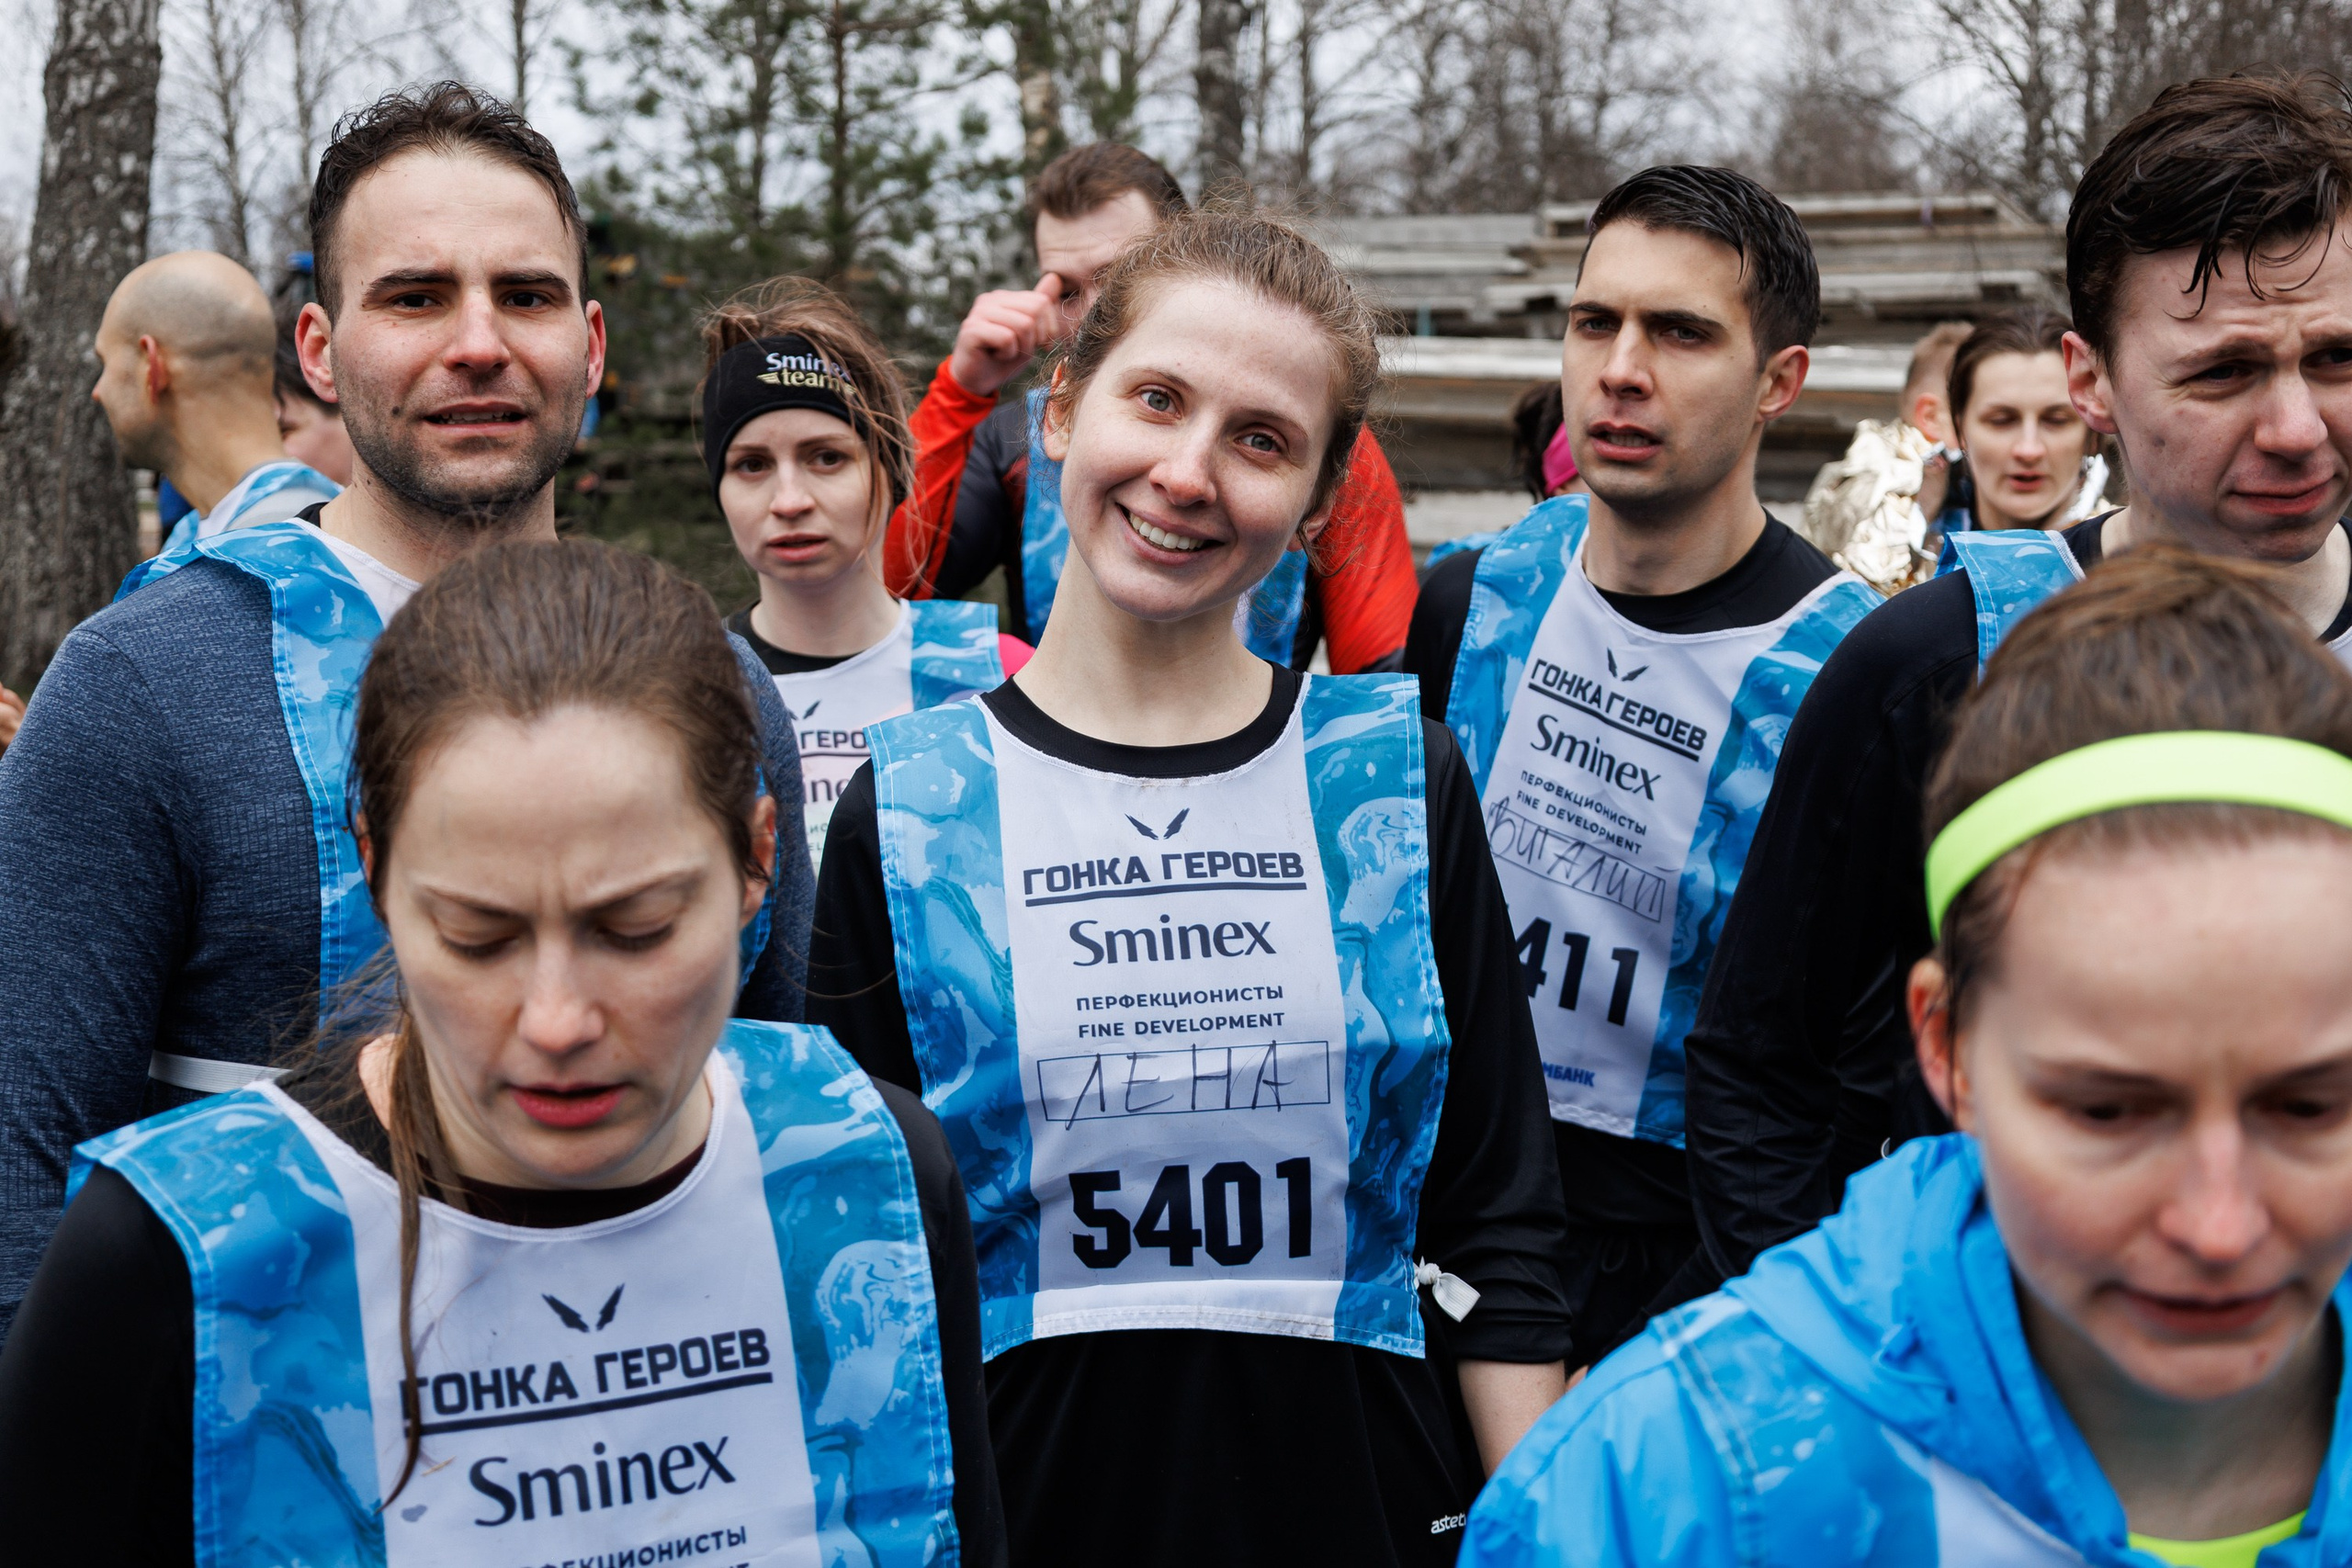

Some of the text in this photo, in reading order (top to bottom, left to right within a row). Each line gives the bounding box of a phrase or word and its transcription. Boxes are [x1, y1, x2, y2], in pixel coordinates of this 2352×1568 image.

[781, 368, 841, 391] team
[1530, 659, 1708, 752] ГОНКА ГЕРОЕВ
[800, 729, 866, 750] ГЕРО
[1529, 713, 1661, 801] Sminex
[1517, 790, 1643, 855] FINE DEVELOPMENT
[1521, 770, 1647, 837] ПЕРФЕКЦИОНИСТЫ
[1023, 851, 1305, 896] ГОНКА ГЕРОЕВ
[1069, 914, 1277, 966] Sminex
[1512, 915, 1640, 1027] 411
[1076, 985, 1284, 1010] ПЕРФЕКЦИОНИСТЫ
[1078, 1012, 1285, 1039] FINE DEVELOPMENT
[1066, 1040, 1295, 1131] ЛЕНА
[1543, 1061, 1596, 1088] МБАНК
[1068, 1156, 1312, 1269] 5401
[400, 1327, 772, 1421] ГОНКА ГЕРОЕВ
[469, 1436, 737, 1527] Sminex
